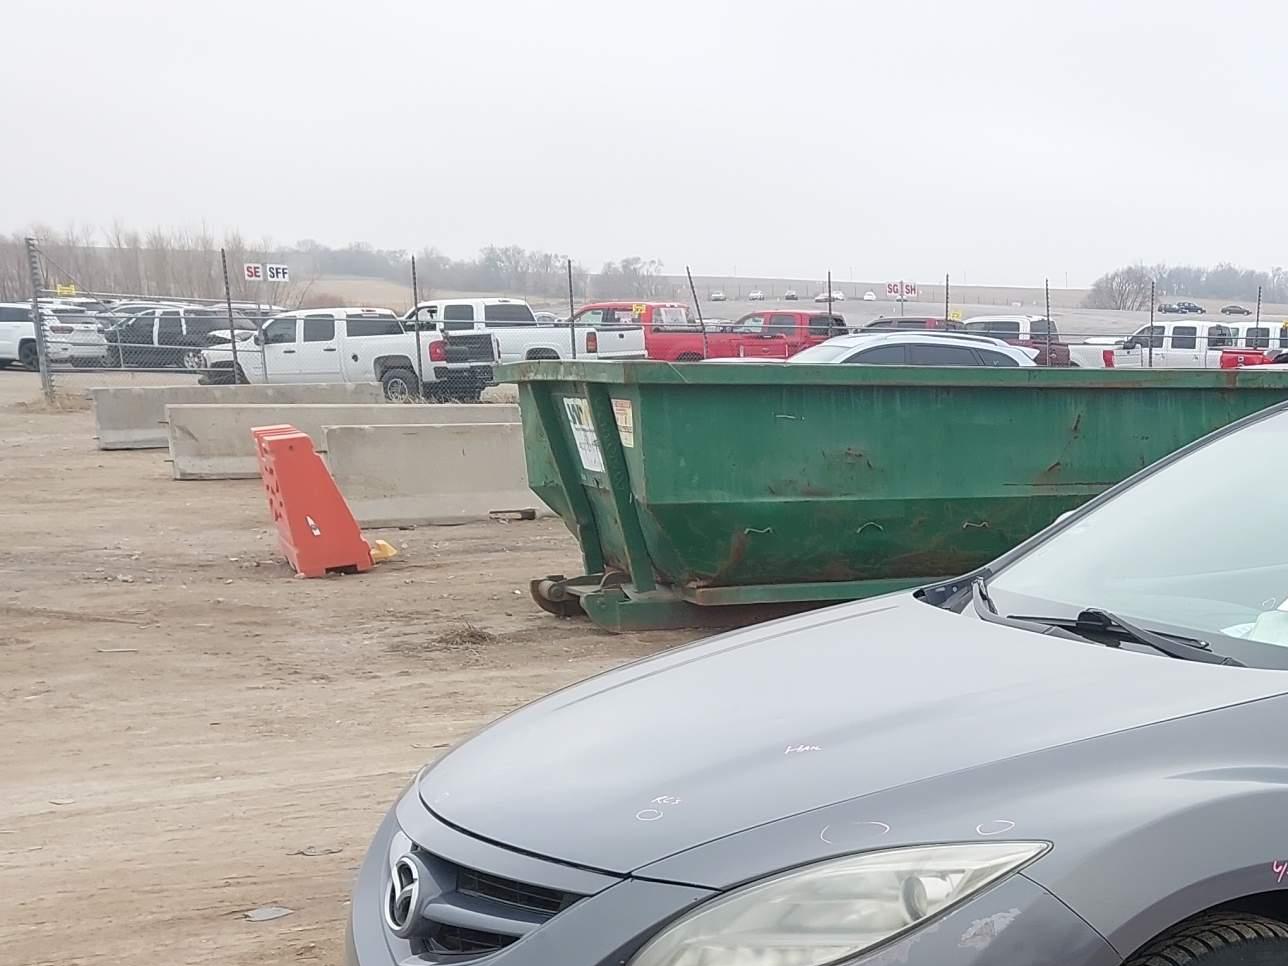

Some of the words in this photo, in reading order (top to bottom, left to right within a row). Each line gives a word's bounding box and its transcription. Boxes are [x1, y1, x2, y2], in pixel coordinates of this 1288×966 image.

[246, 265, 261, 278] SE
[268, 266, 289, 279] SFF
[887, 283, 899, 294] SG
[905, 284, 916, 295] SH
